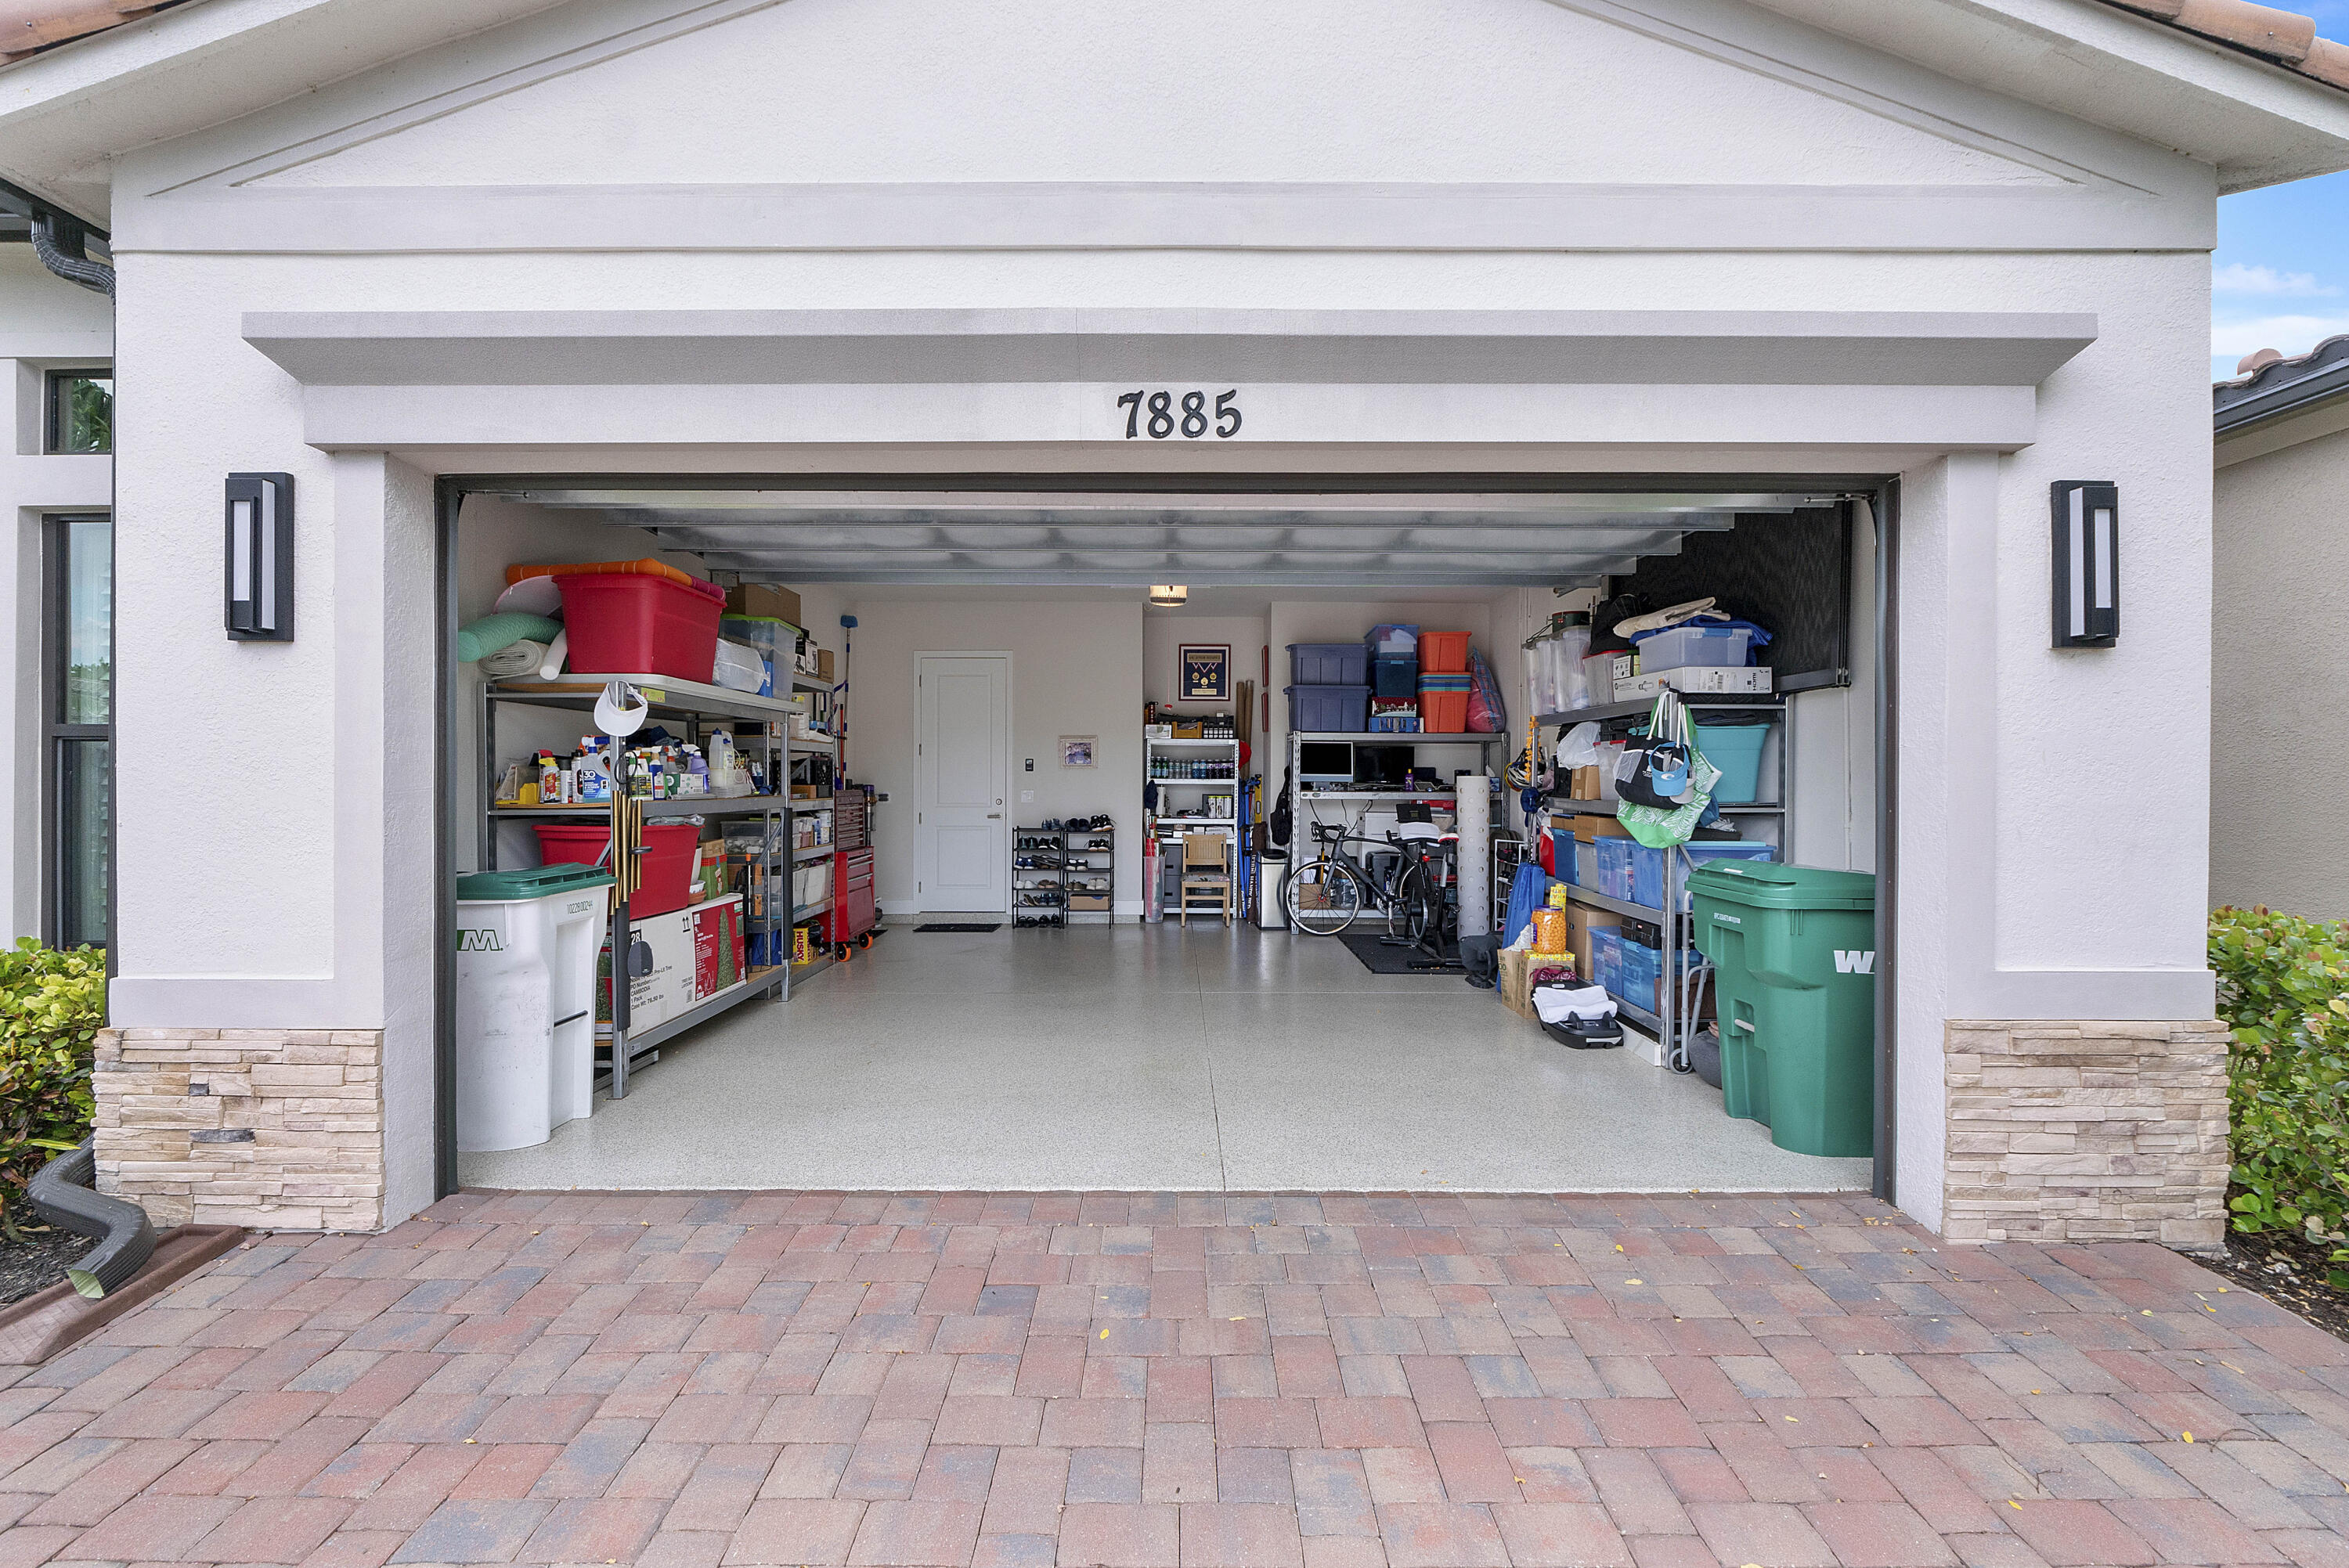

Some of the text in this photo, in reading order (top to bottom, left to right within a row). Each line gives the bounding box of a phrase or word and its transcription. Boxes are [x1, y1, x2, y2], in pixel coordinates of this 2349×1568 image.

[1117, 388, 1242, 438] 7885
[1834, 950, 1875, 975] W
[630, 986, 651, 997] CAMBODIA
